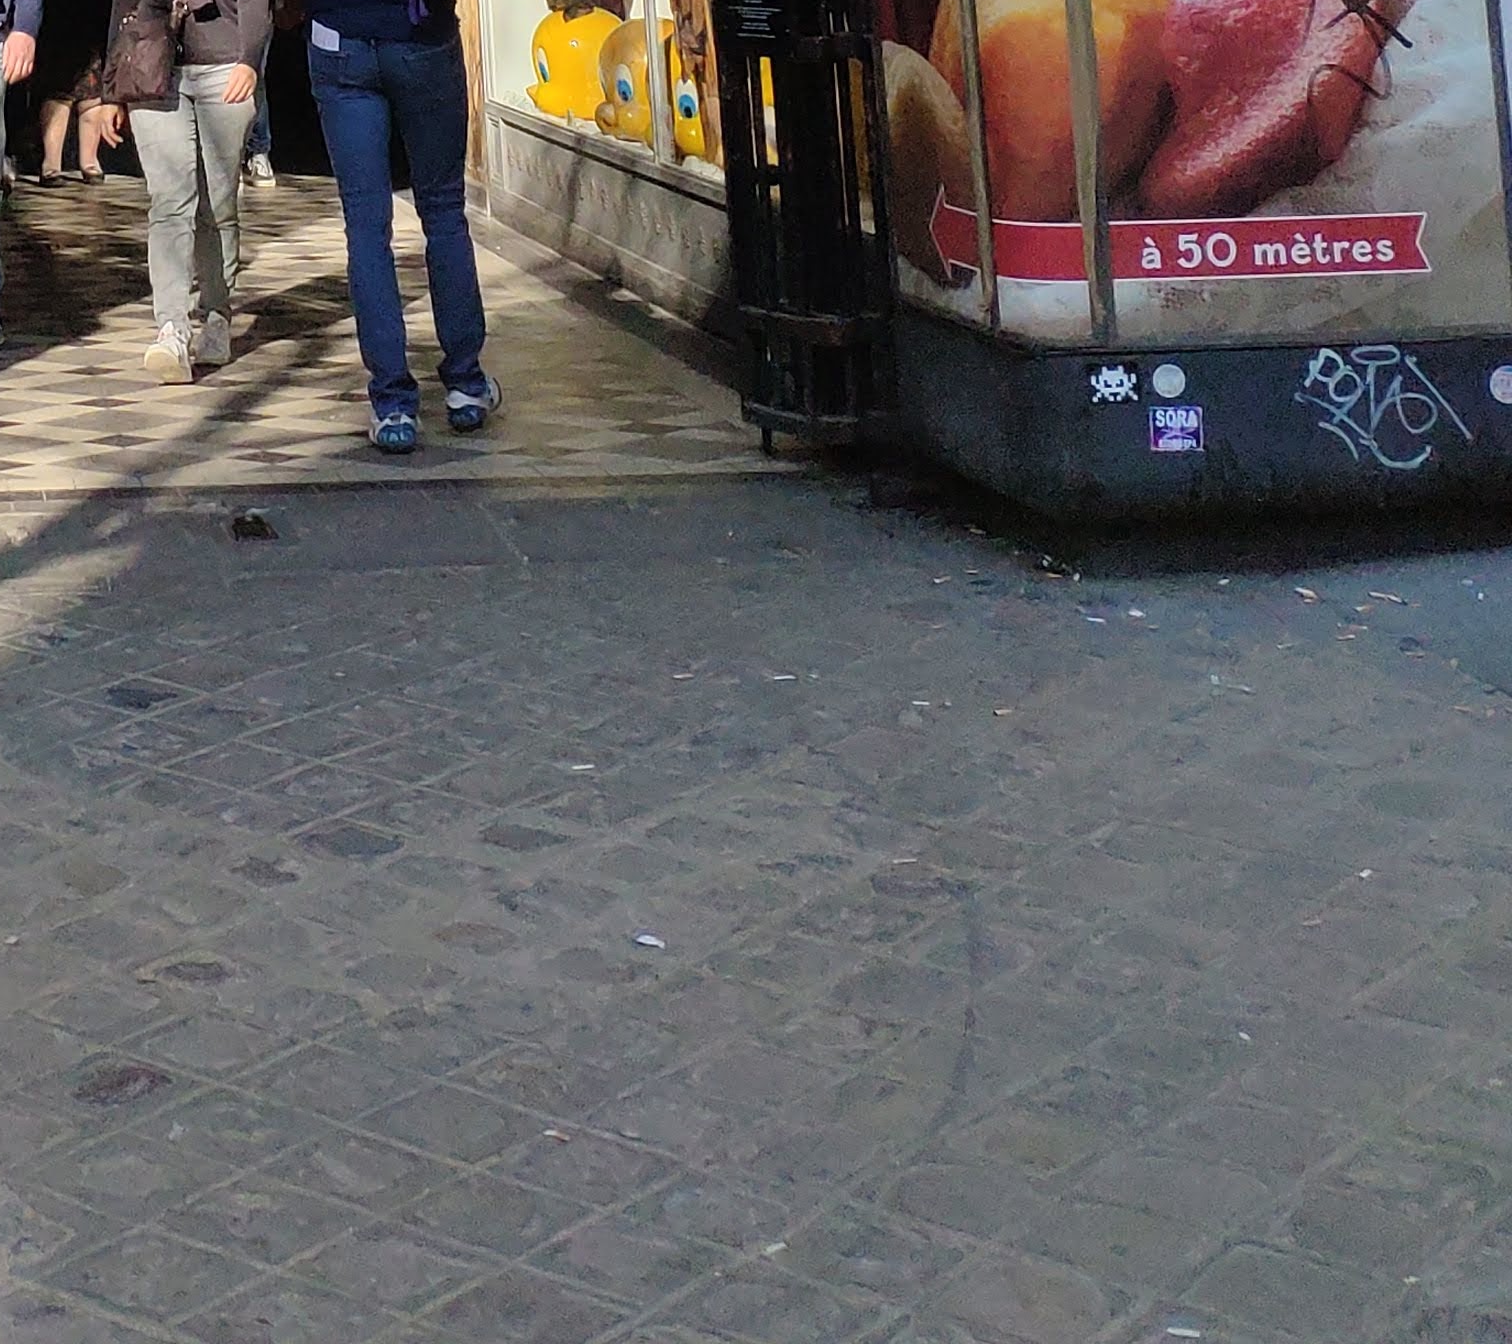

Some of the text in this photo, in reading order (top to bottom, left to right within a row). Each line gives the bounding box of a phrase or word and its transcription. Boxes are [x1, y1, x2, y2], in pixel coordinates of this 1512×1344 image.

[1141, 231, 1396, 269] à 50 mètres
